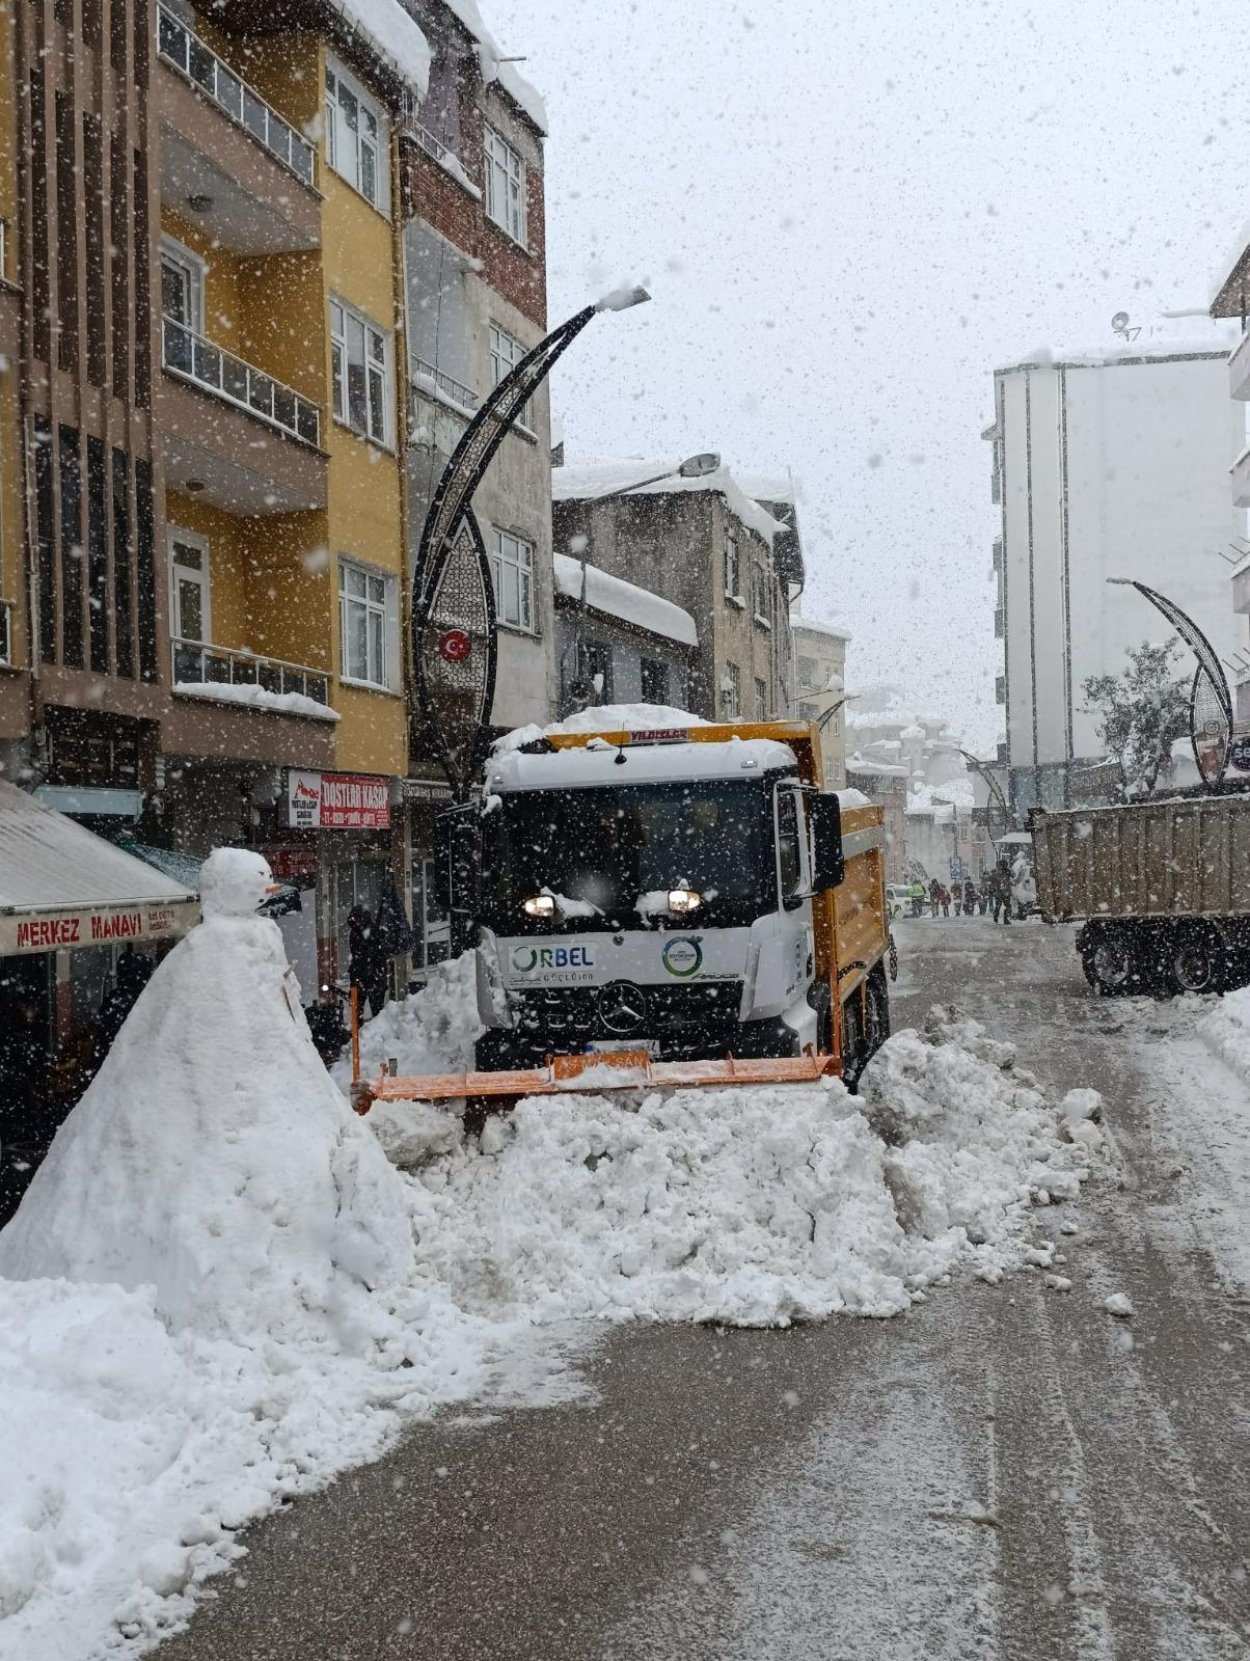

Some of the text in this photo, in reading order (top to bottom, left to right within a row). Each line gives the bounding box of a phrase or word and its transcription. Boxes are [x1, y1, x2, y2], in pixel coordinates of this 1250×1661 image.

[323, 782, 361, 809] DOSTLAR
[363, 785, 388, 810] KASAP
[17, 918, 80, 947] MERKEZ
[91, 912, 142, 939] MANAVI
[512, 946, 594, 972] ORBEL
